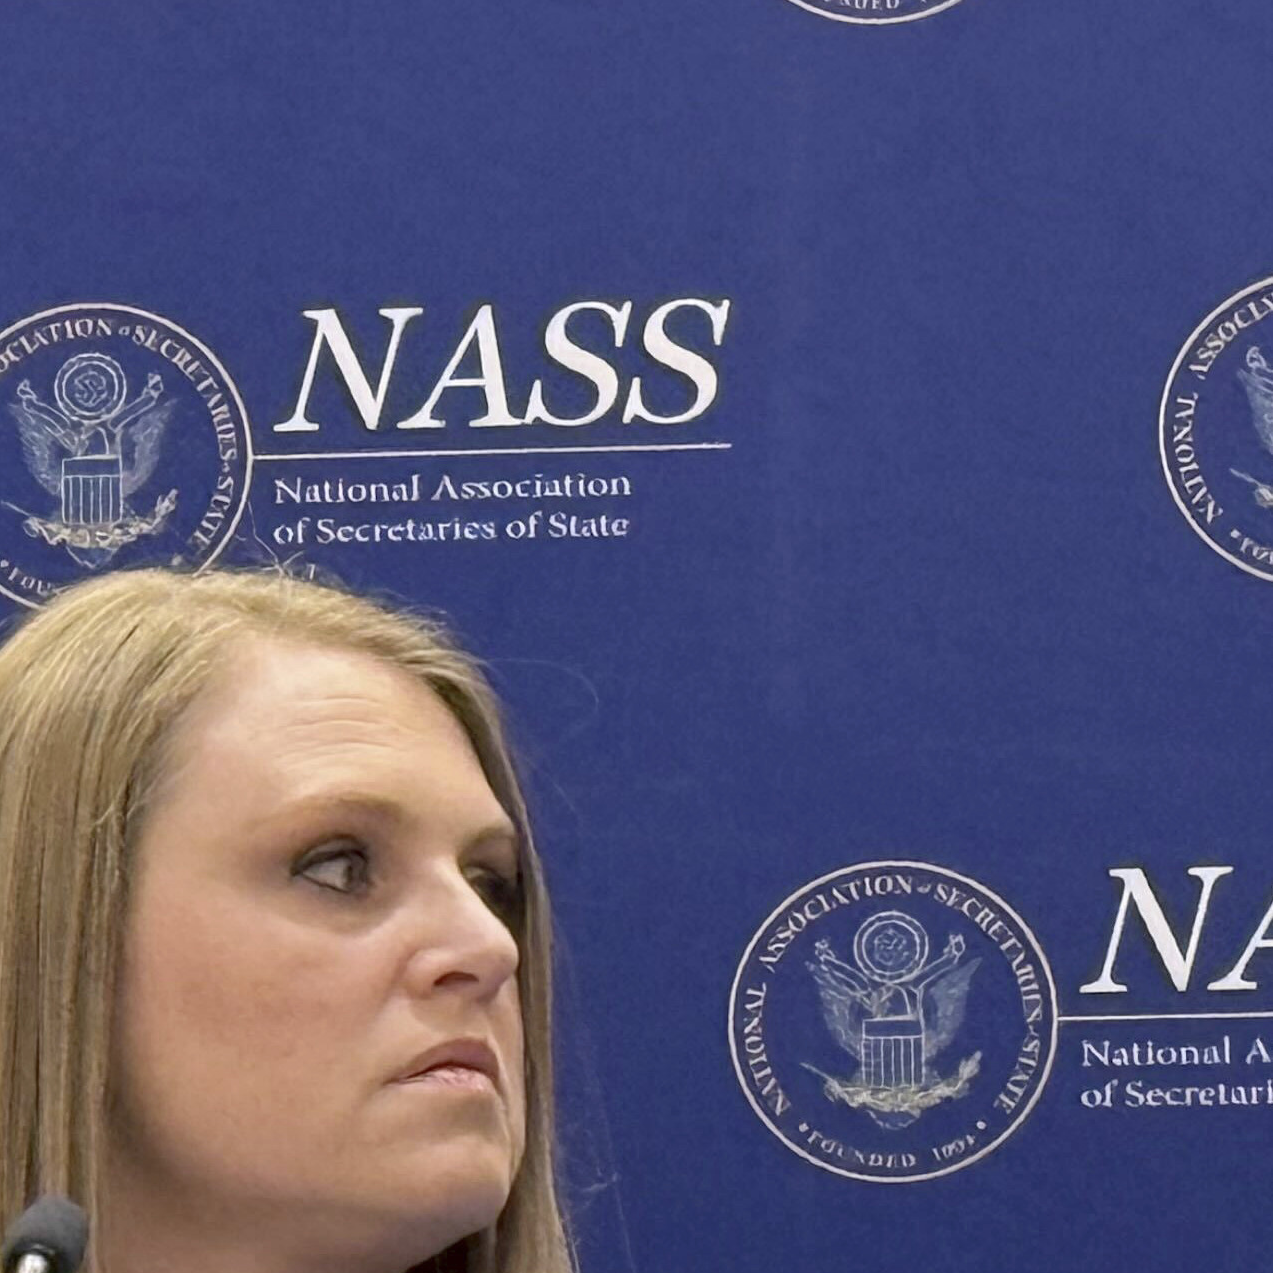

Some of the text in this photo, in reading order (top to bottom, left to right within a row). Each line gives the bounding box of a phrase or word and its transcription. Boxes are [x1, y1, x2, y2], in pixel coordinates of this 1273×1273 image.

[274, 299, 730, 431] NASS
[275, 474, 630, 503] National Association
[274, 511, 629, 544] of Secretaries of State
[1083, 1036, 1230, 1066] National
[1081, 1079, 1273, 1107] of Secretari
